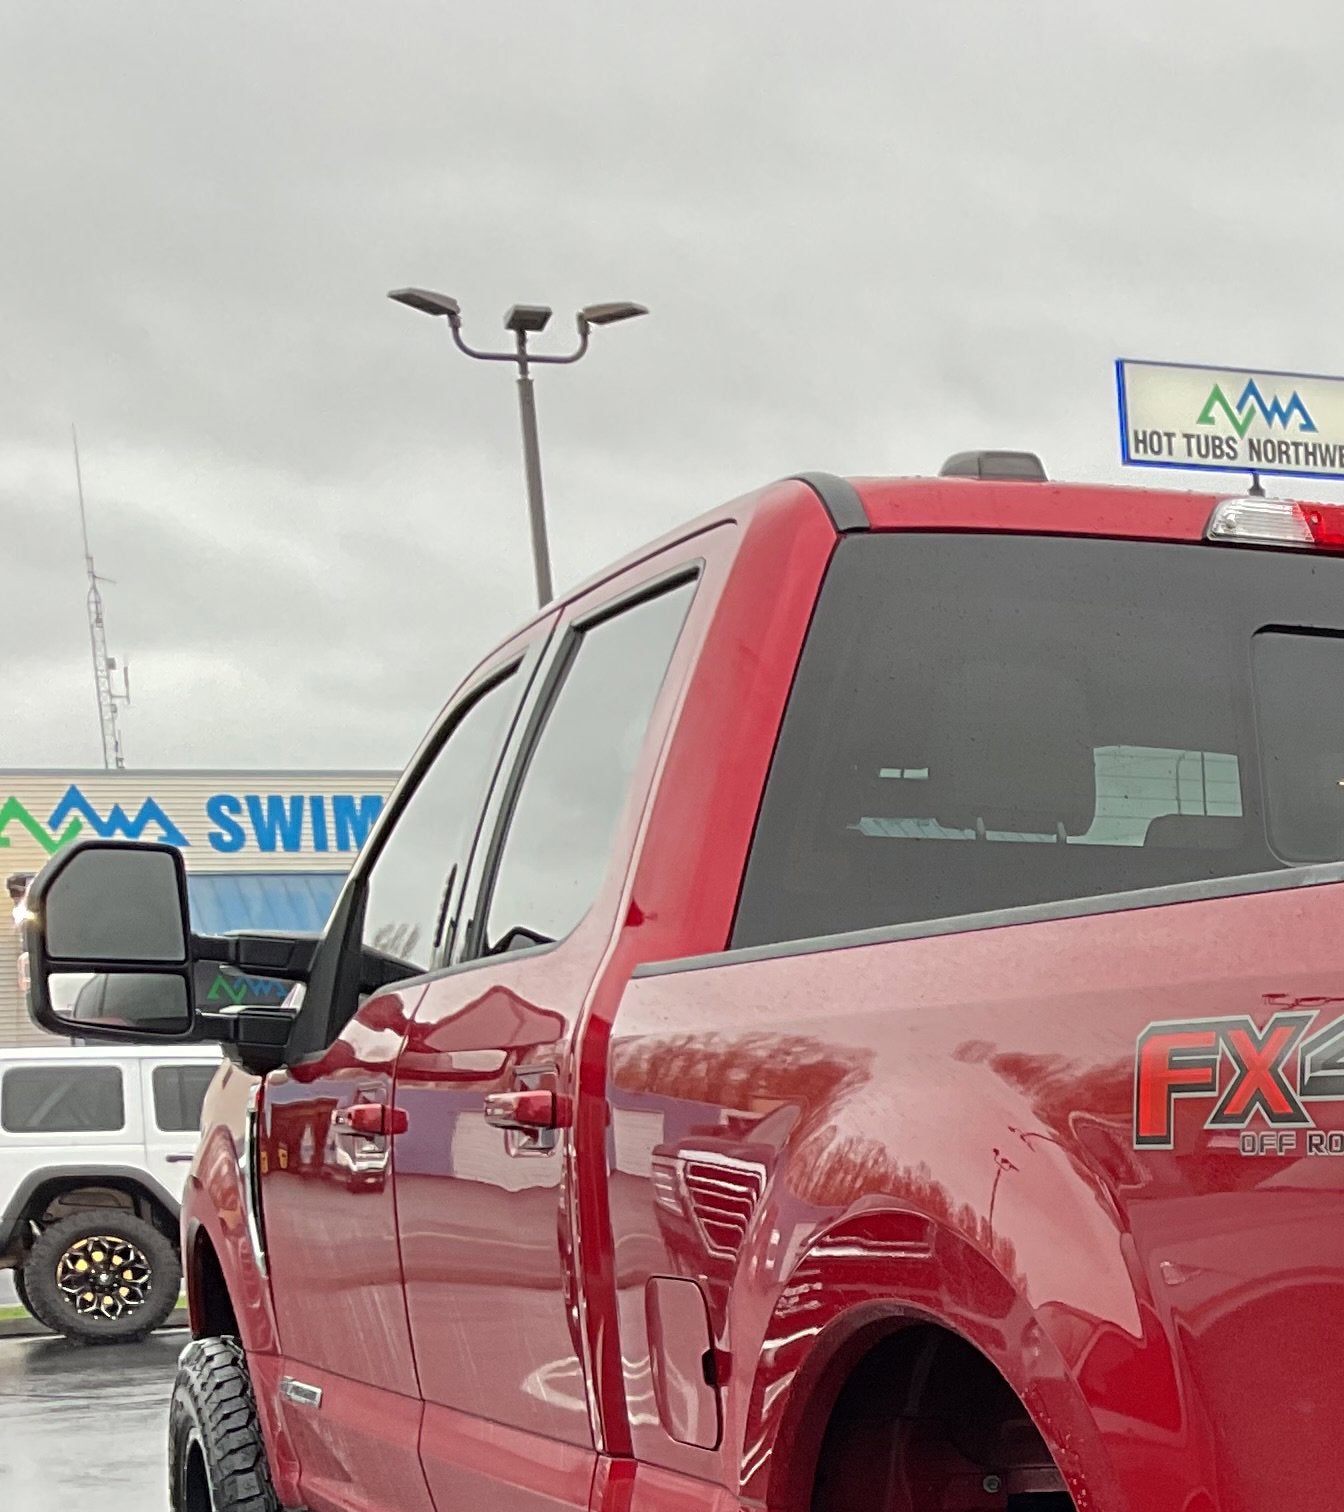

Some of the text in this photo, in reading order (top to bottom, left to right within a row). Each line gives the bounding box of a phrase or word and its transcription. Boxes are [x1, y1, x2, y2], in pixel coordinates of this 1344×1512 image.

[1133, 429, 1176, 457] HOT
[1183, 433, 1238, 461] TUBS
[206, 794, 384, 853] SWIM
[1240, 1131, 1296, 1156] OFF
